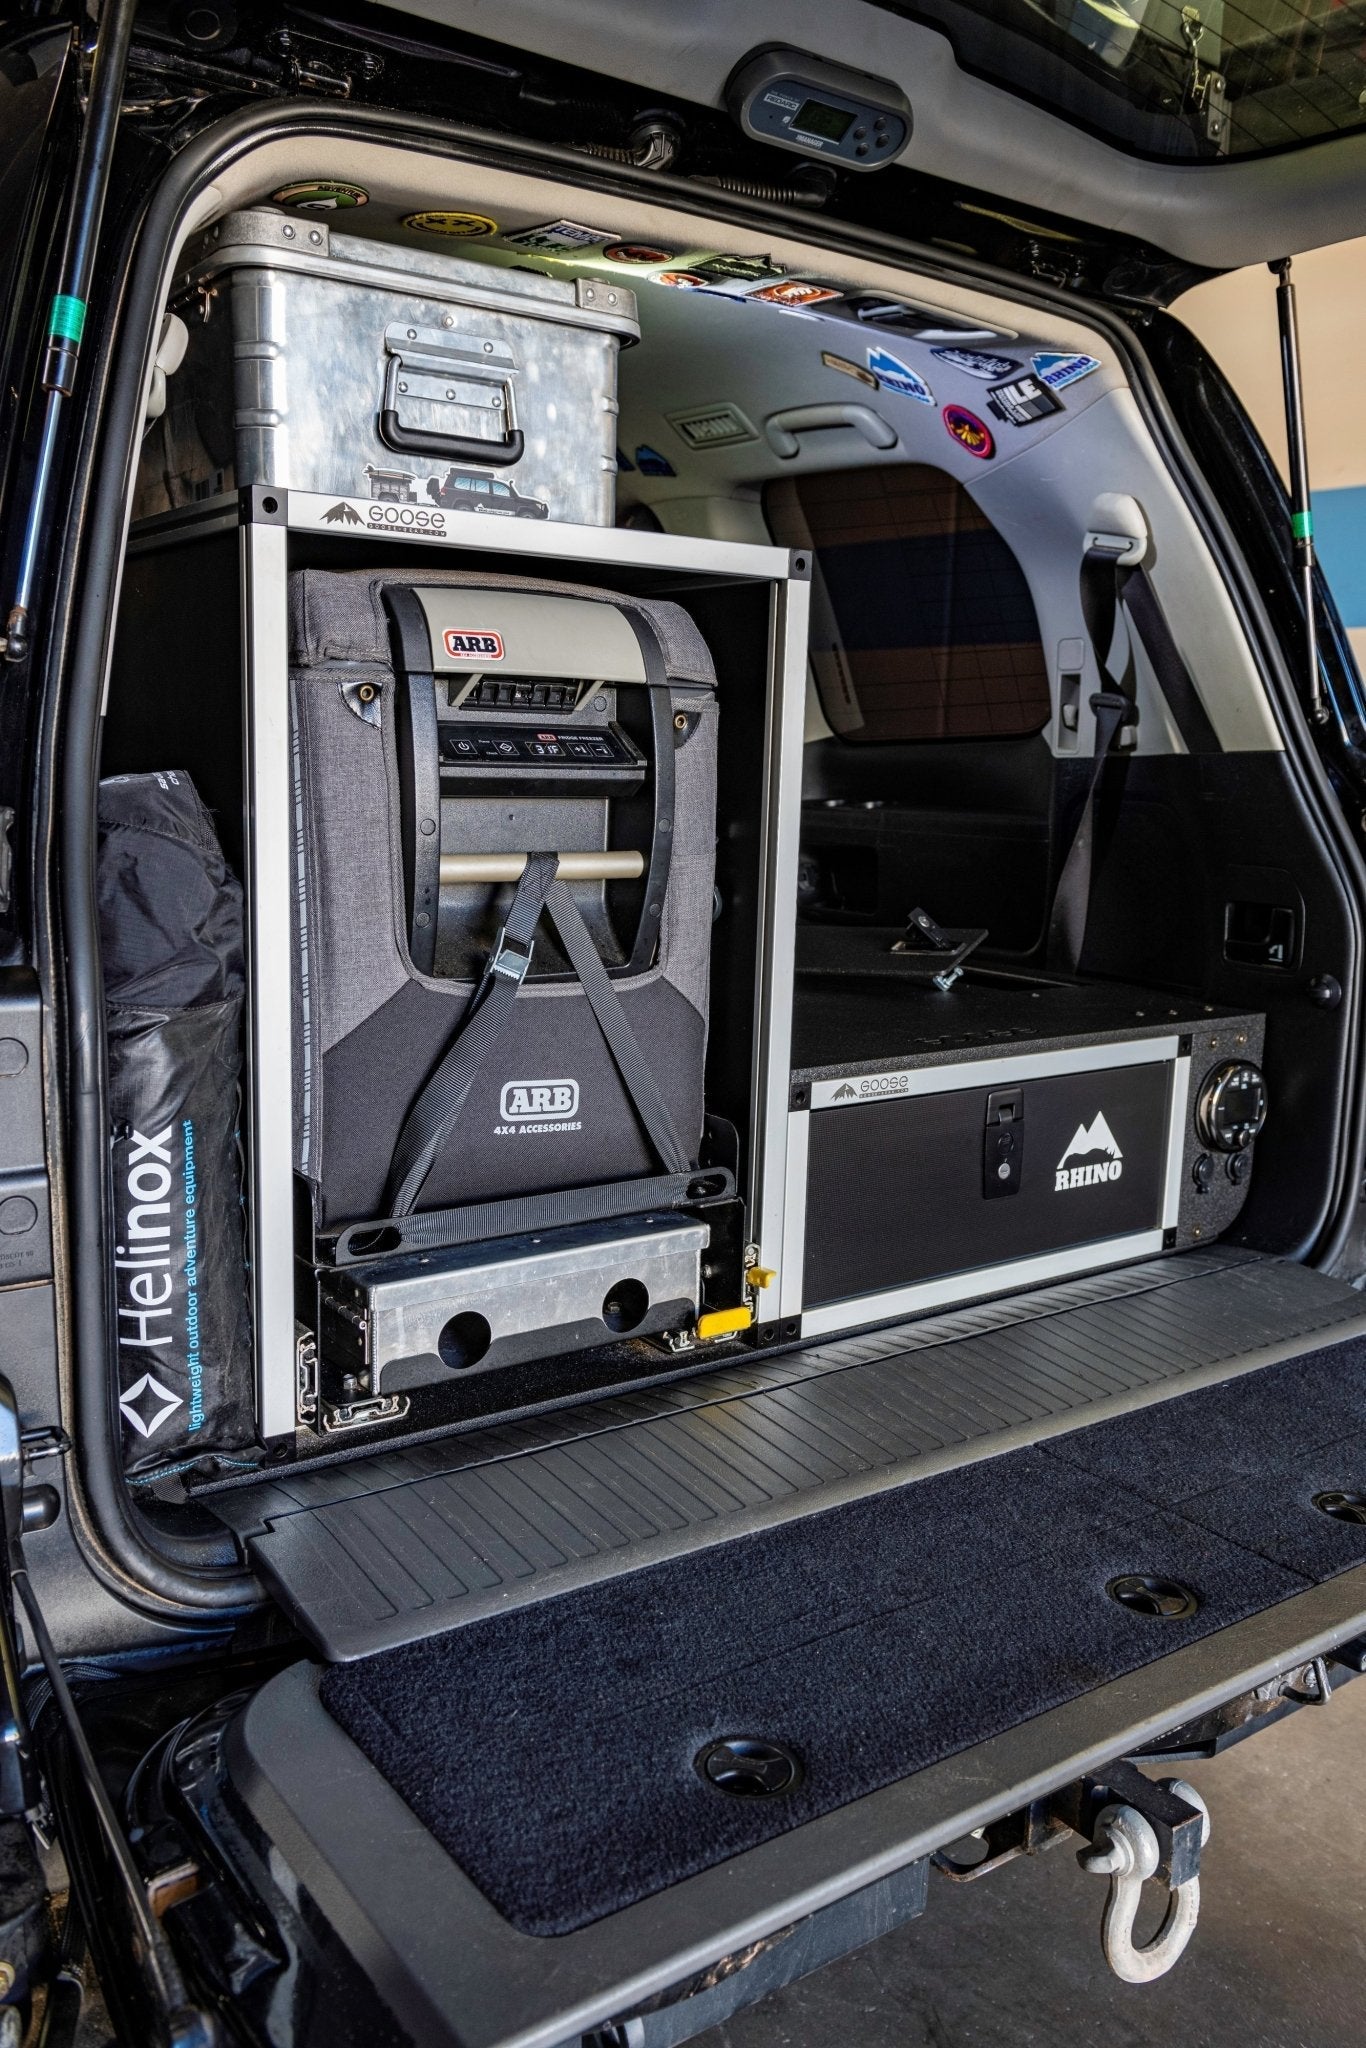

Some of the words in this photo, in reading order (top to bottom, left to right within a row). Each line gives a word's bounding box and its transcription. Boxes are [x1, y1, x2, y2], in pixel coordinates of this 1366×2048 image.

[766, 95, 798, 110] REDARC
[1042, 357, 1091, 385] RHINO
[453, 636, 498, 653] ARB
[508, 1086, 572, 1114] ARB
[493, 1125, 516, 1135] 4X4
[518, 1121, 582, 1134] ACCESSORIES
[182, 1119, 196, 1205] equipment
[1054, 1159, 1123, 1192] RHINO
[114, 1125, 173, 1347] Helinox
[184, 1208, 197, 1287] adventure
[185, 1291, 199, 1349] outdoor
[187, 1352, 205, 1432] lightweight
